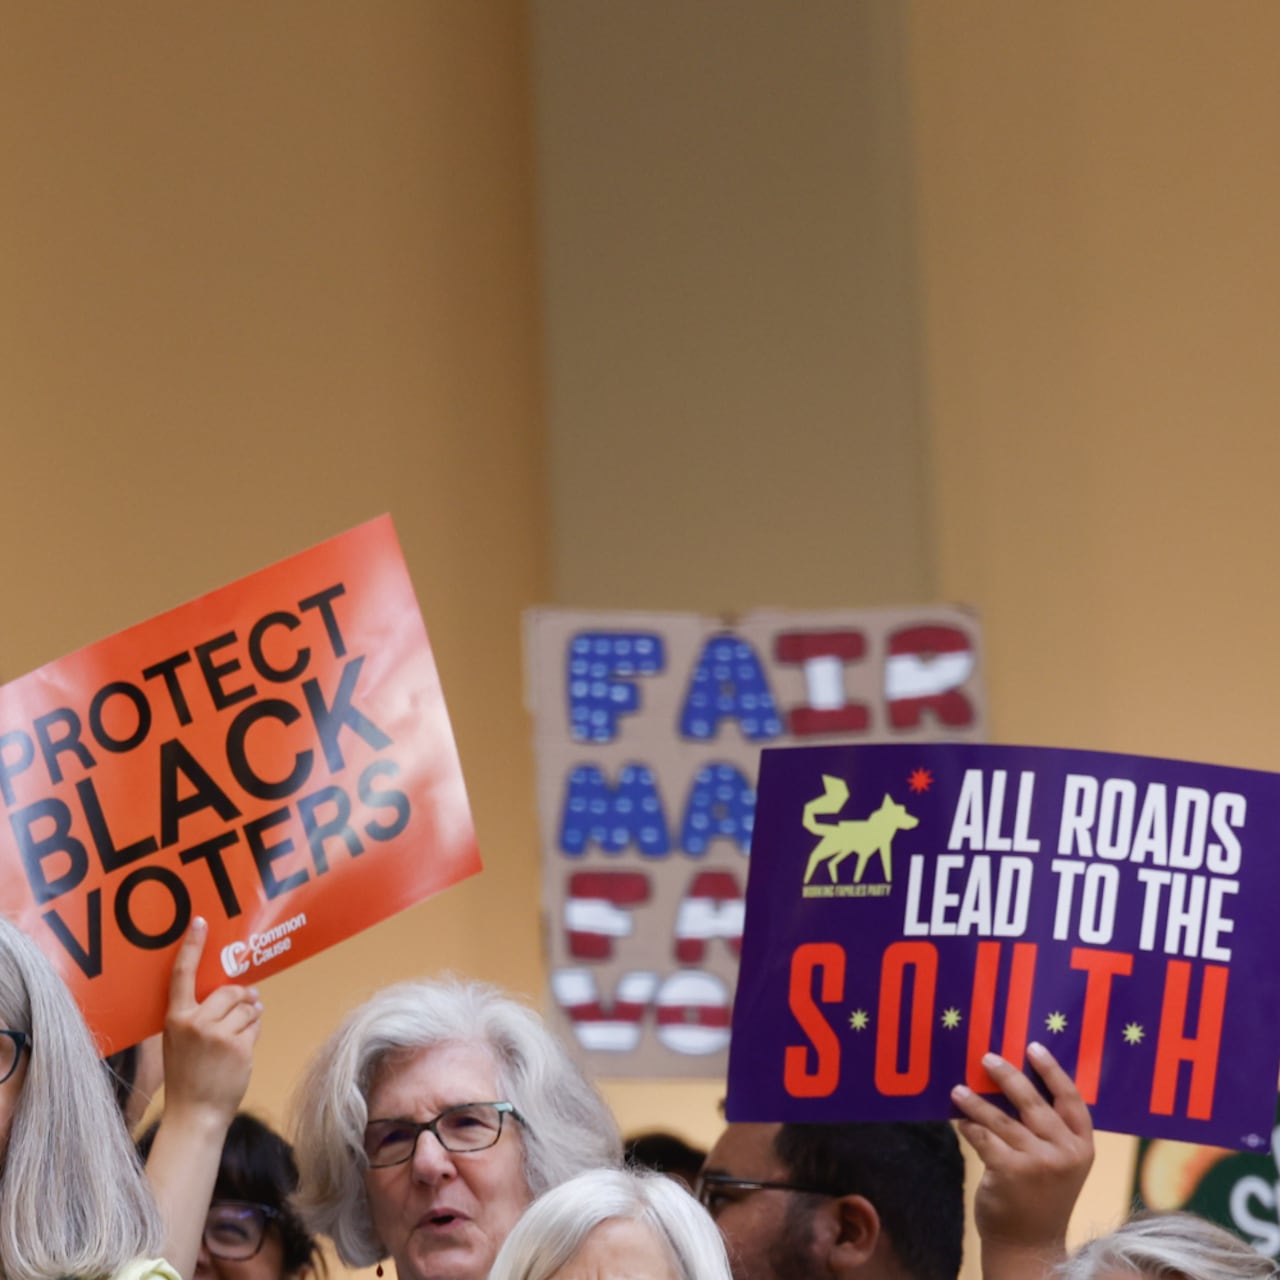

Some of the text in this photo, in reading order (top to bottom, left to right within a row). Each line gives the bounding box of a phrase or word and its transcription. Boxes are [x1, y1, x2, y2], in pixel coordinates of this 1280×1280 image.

[568, 623, 976, 741] FAIR
[9, 655, 395, 905] BLACK
[559, 763, 757, 857] MA
[948, 769, 1246, 874] ALL ROADS
[42, 759, 410, 980] VOTERS
[903, 855, 1240, 962] LEAD TO THE
[249, 912, 306, 951] Common
